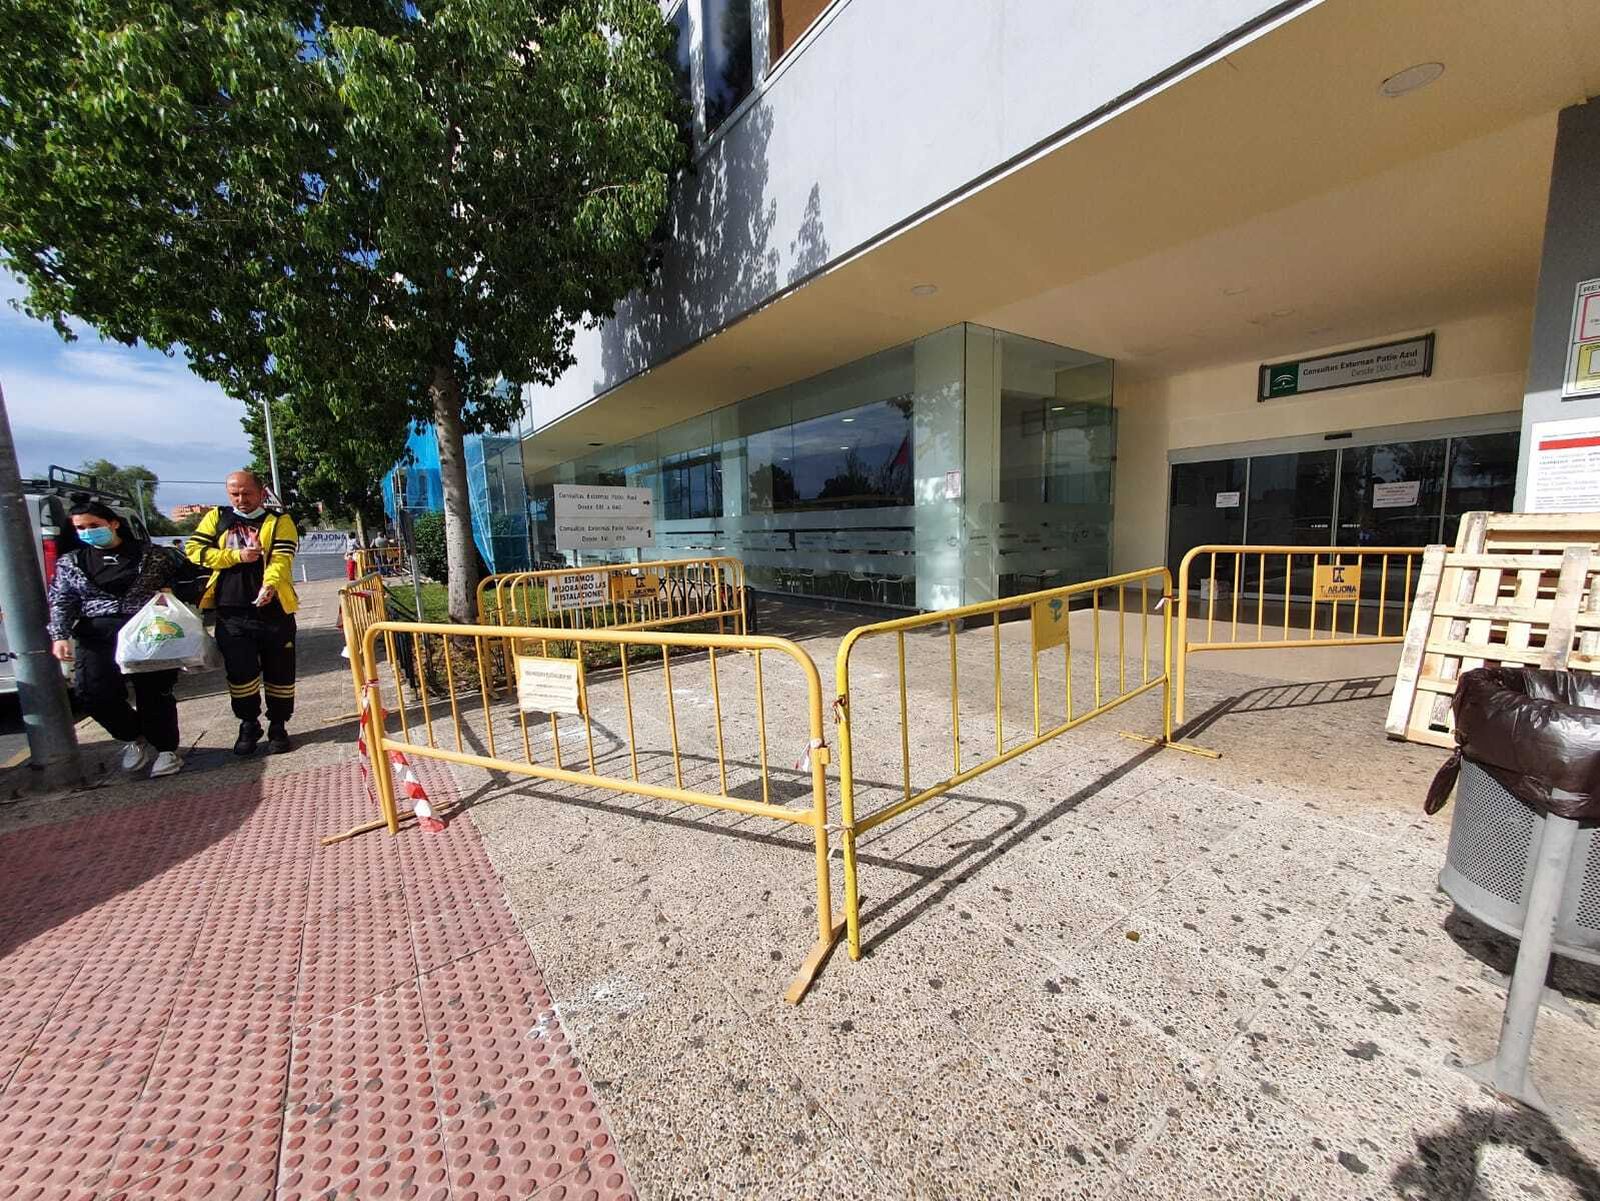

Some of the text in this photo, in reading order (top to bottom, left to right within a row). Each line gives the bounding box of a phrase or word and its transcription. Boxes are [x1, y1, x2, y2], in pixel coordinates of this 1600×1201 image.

[1303, 348, 1418, 376] Consultas Externas Patio Azul
[559, 492, 585, 500] Consultas
[312, 533, 347, 542] ARJONA
[564, 574, 594, 584] ESTAMOS
[1328, 585, 1357, 594] ARJONA
